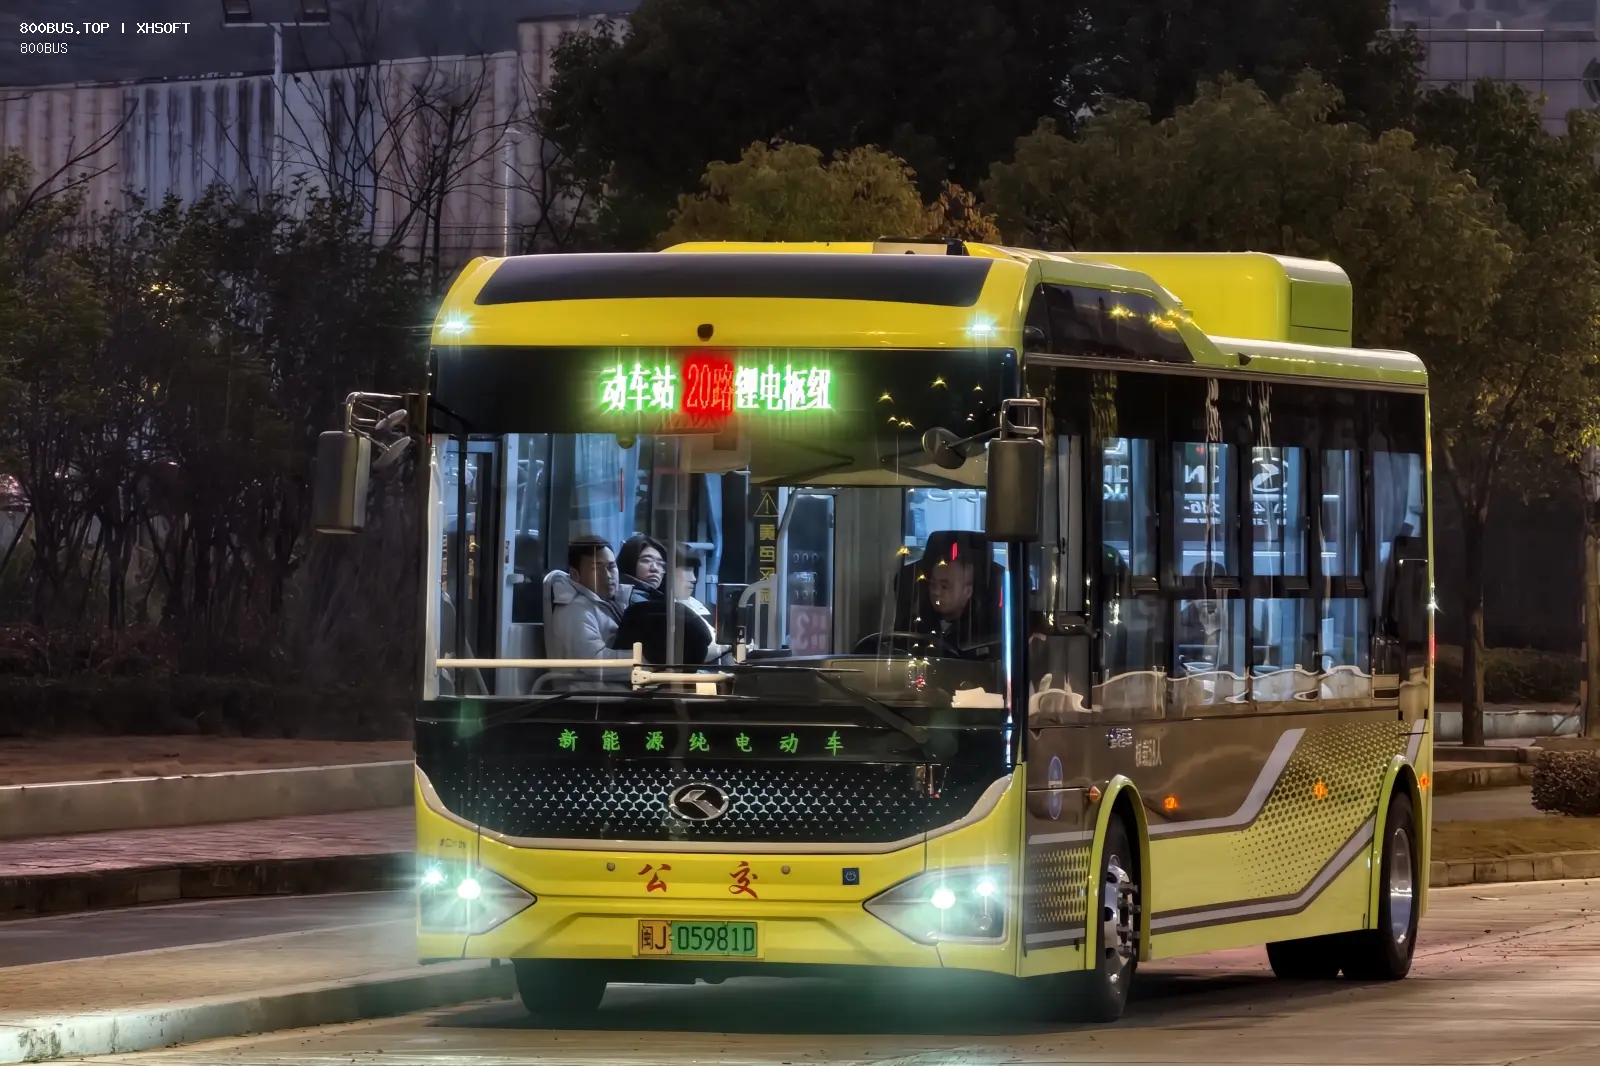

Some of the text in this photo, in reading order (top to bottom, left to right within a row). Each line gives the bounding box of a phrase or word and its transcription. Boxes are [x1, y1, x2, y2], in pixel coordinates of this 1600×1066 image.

[601, 362, 832, 412] 动车站 20路 锂电枢纽
[559, 729, 844, 756] 新能源纯电动车
[638, 860, 758, 900] 公交
